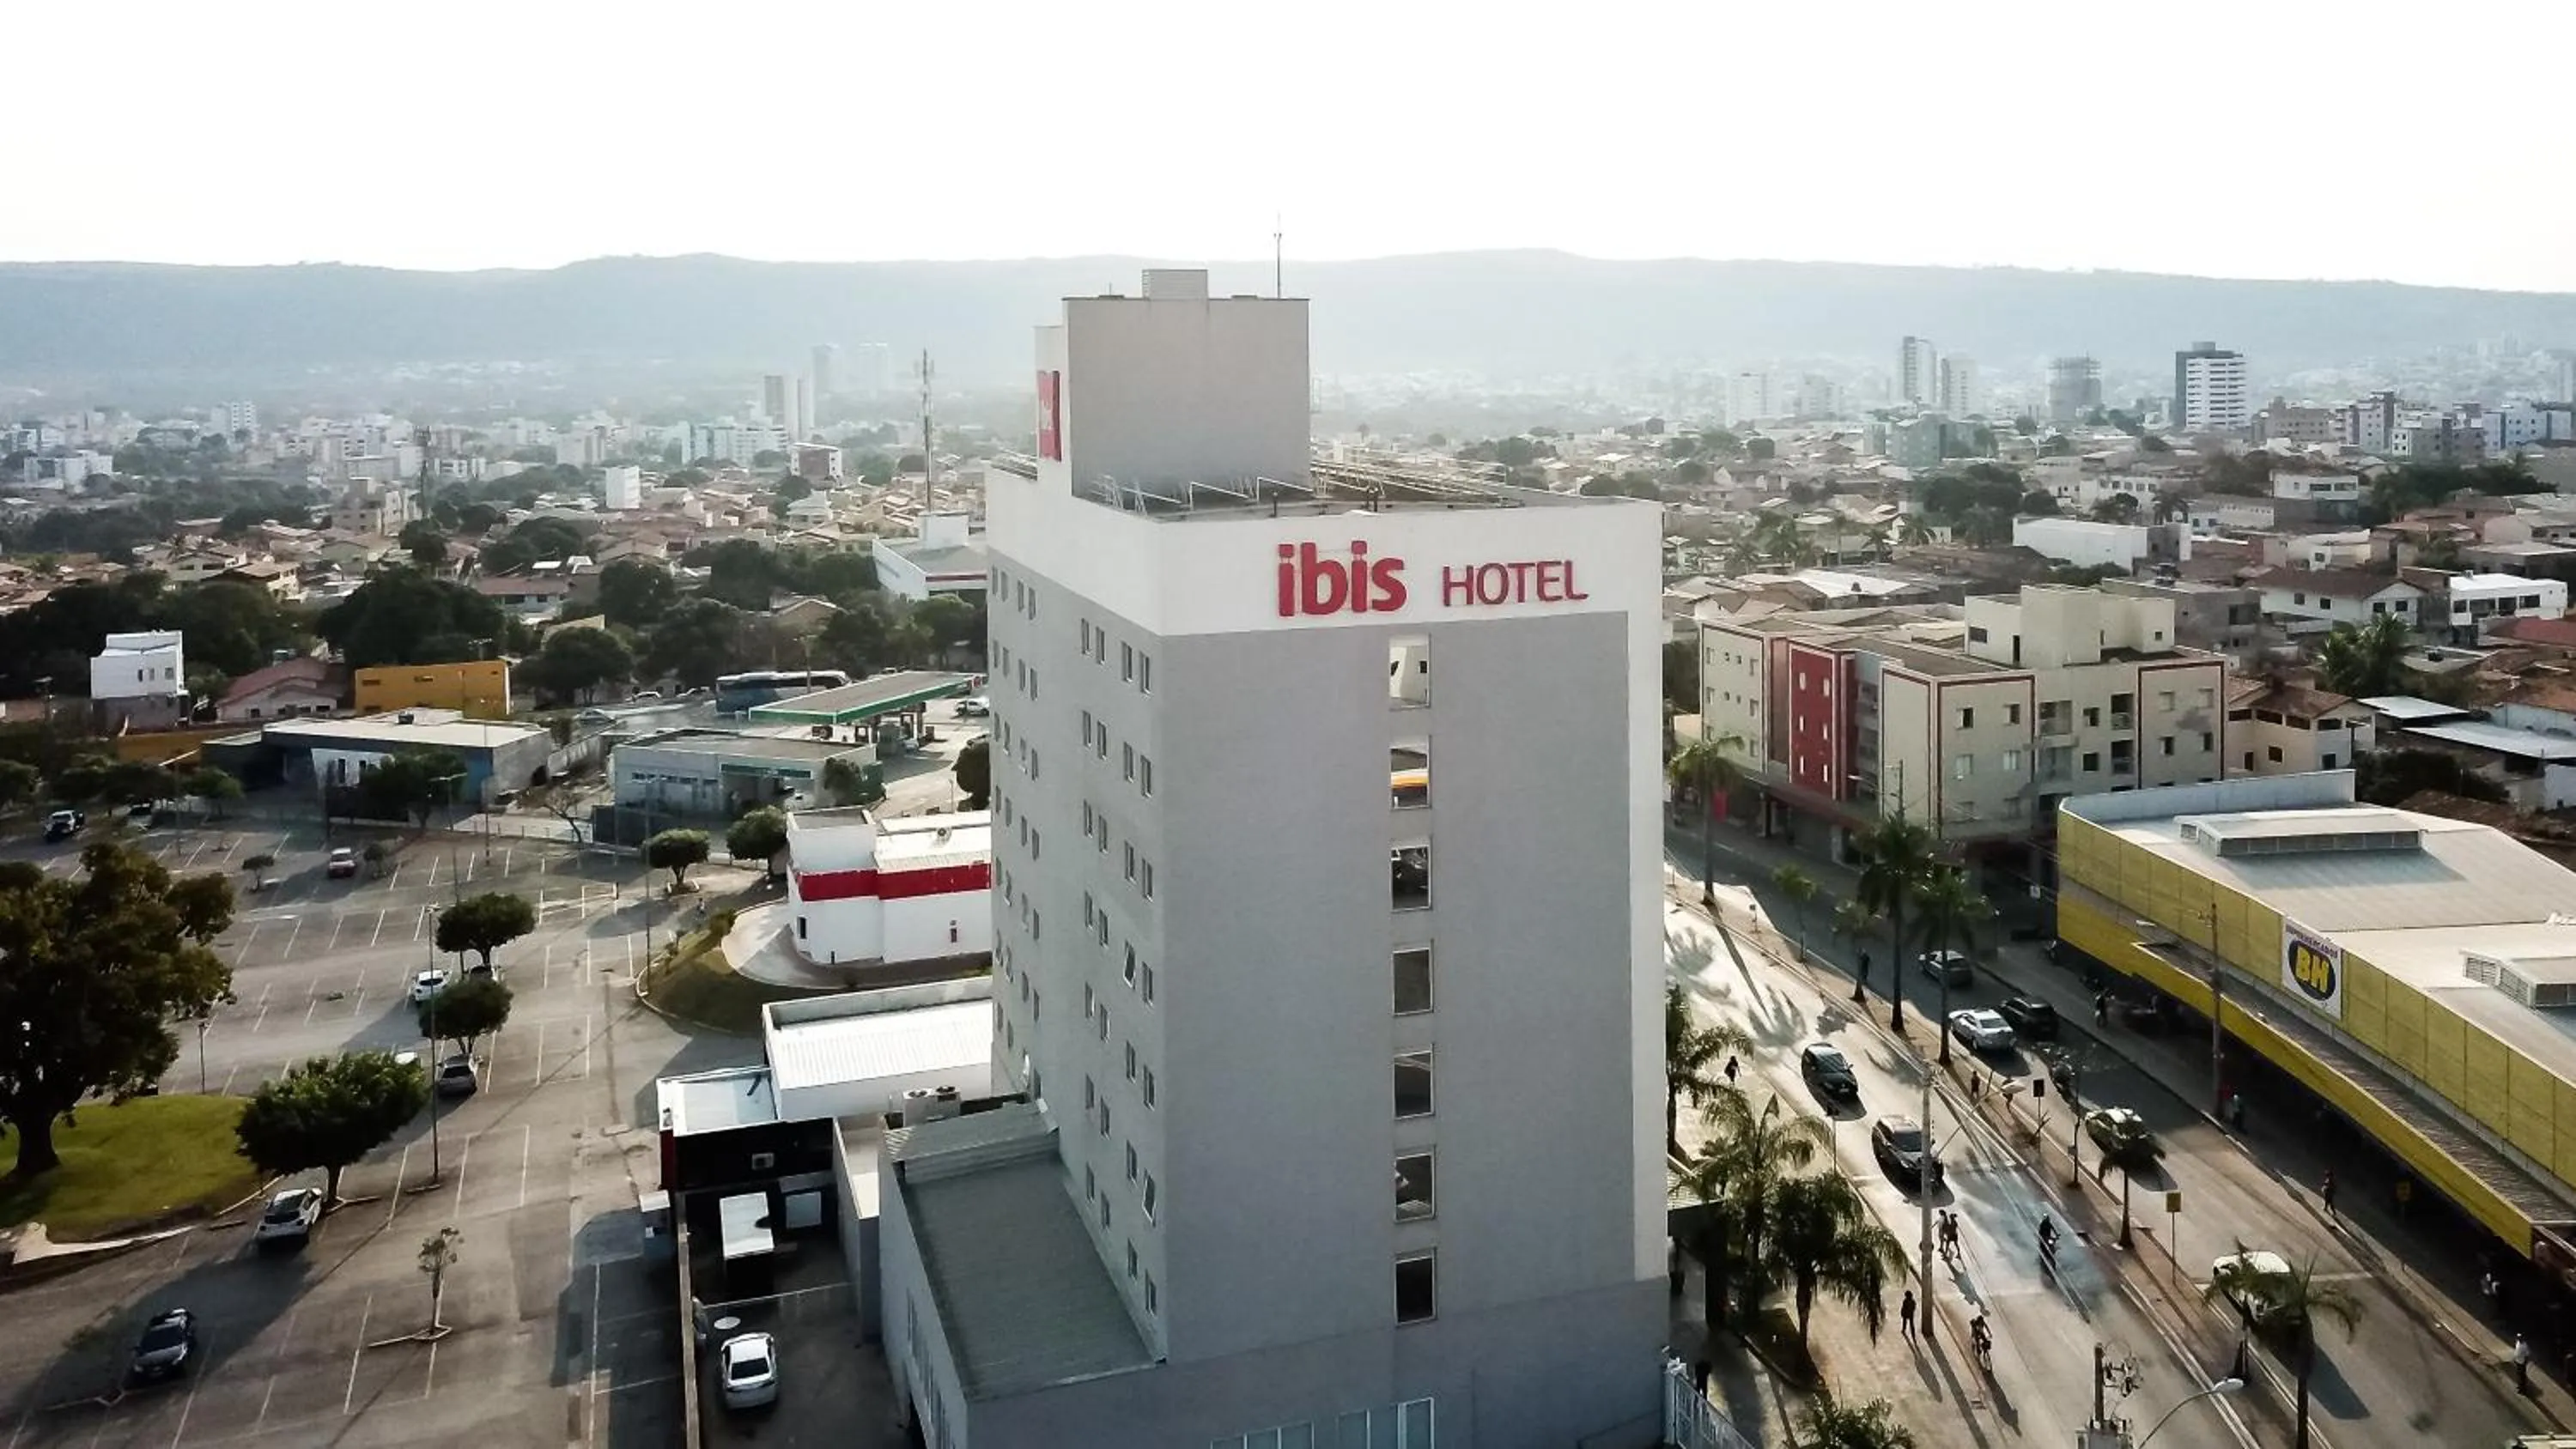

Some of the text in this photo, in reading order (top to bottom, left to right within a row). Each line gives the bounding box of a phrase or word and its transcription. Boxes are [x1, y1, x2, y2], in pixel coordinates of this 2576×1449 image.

[1278, 541, 1589, 616] ibis HOTEL
[2295, 945, 2330, 993] BH
